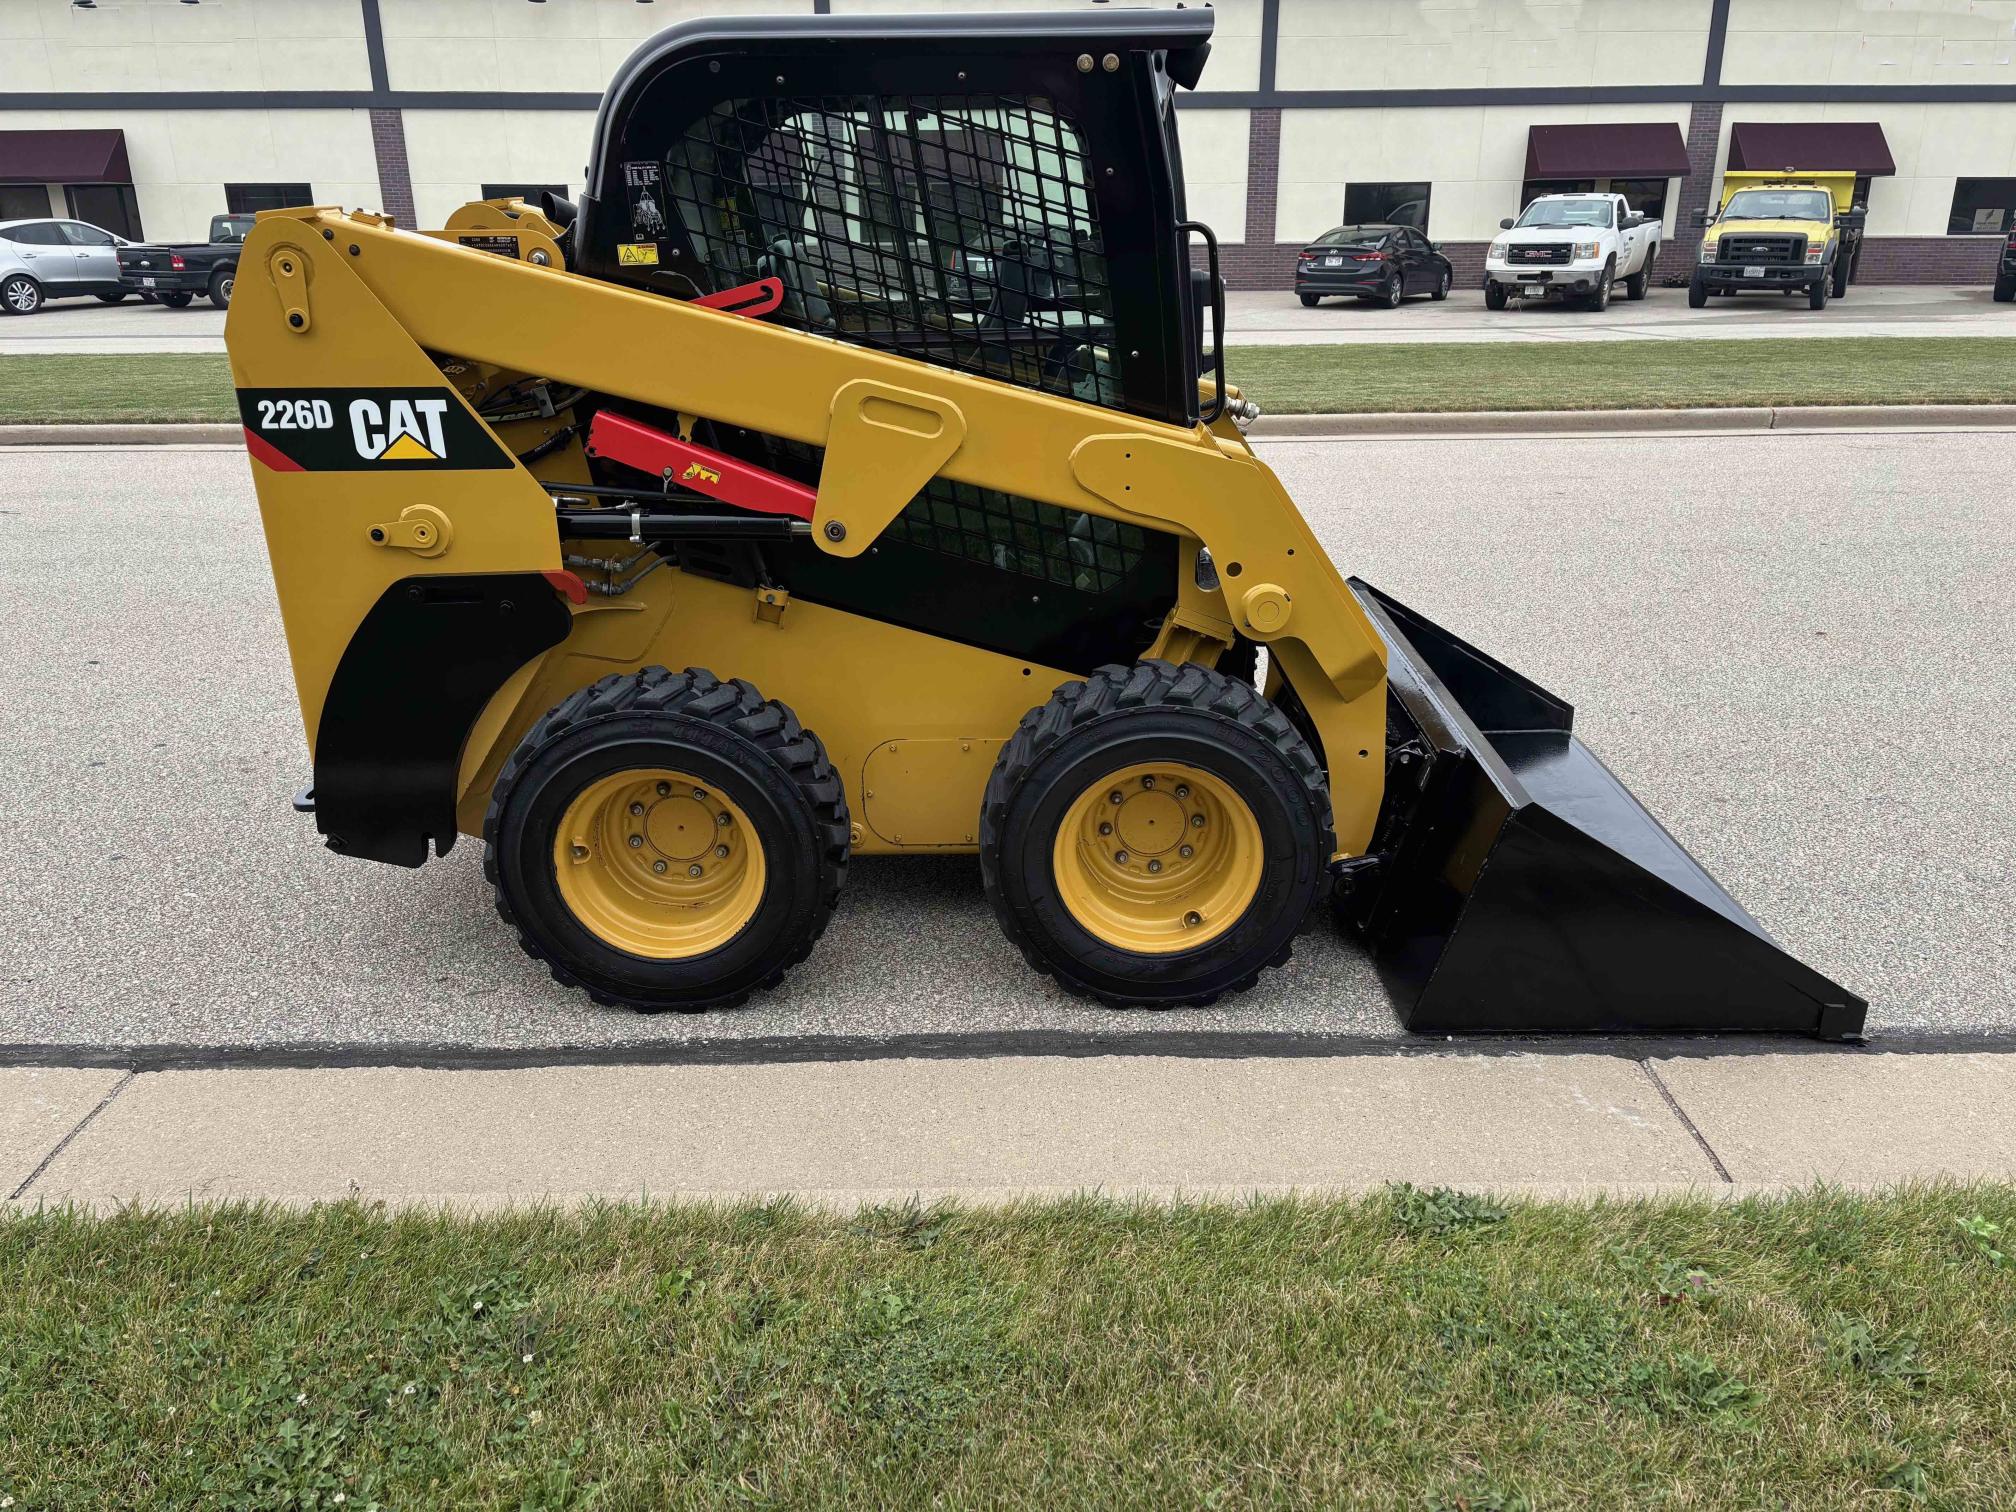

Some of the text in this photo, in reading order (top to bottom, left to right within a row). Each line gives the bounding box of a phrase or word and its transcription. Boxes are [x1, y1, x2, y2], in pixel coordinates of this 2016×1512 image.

[1524, 250, 1552, 258] GMC
[257, 398, 448, 460] 226D CAT
